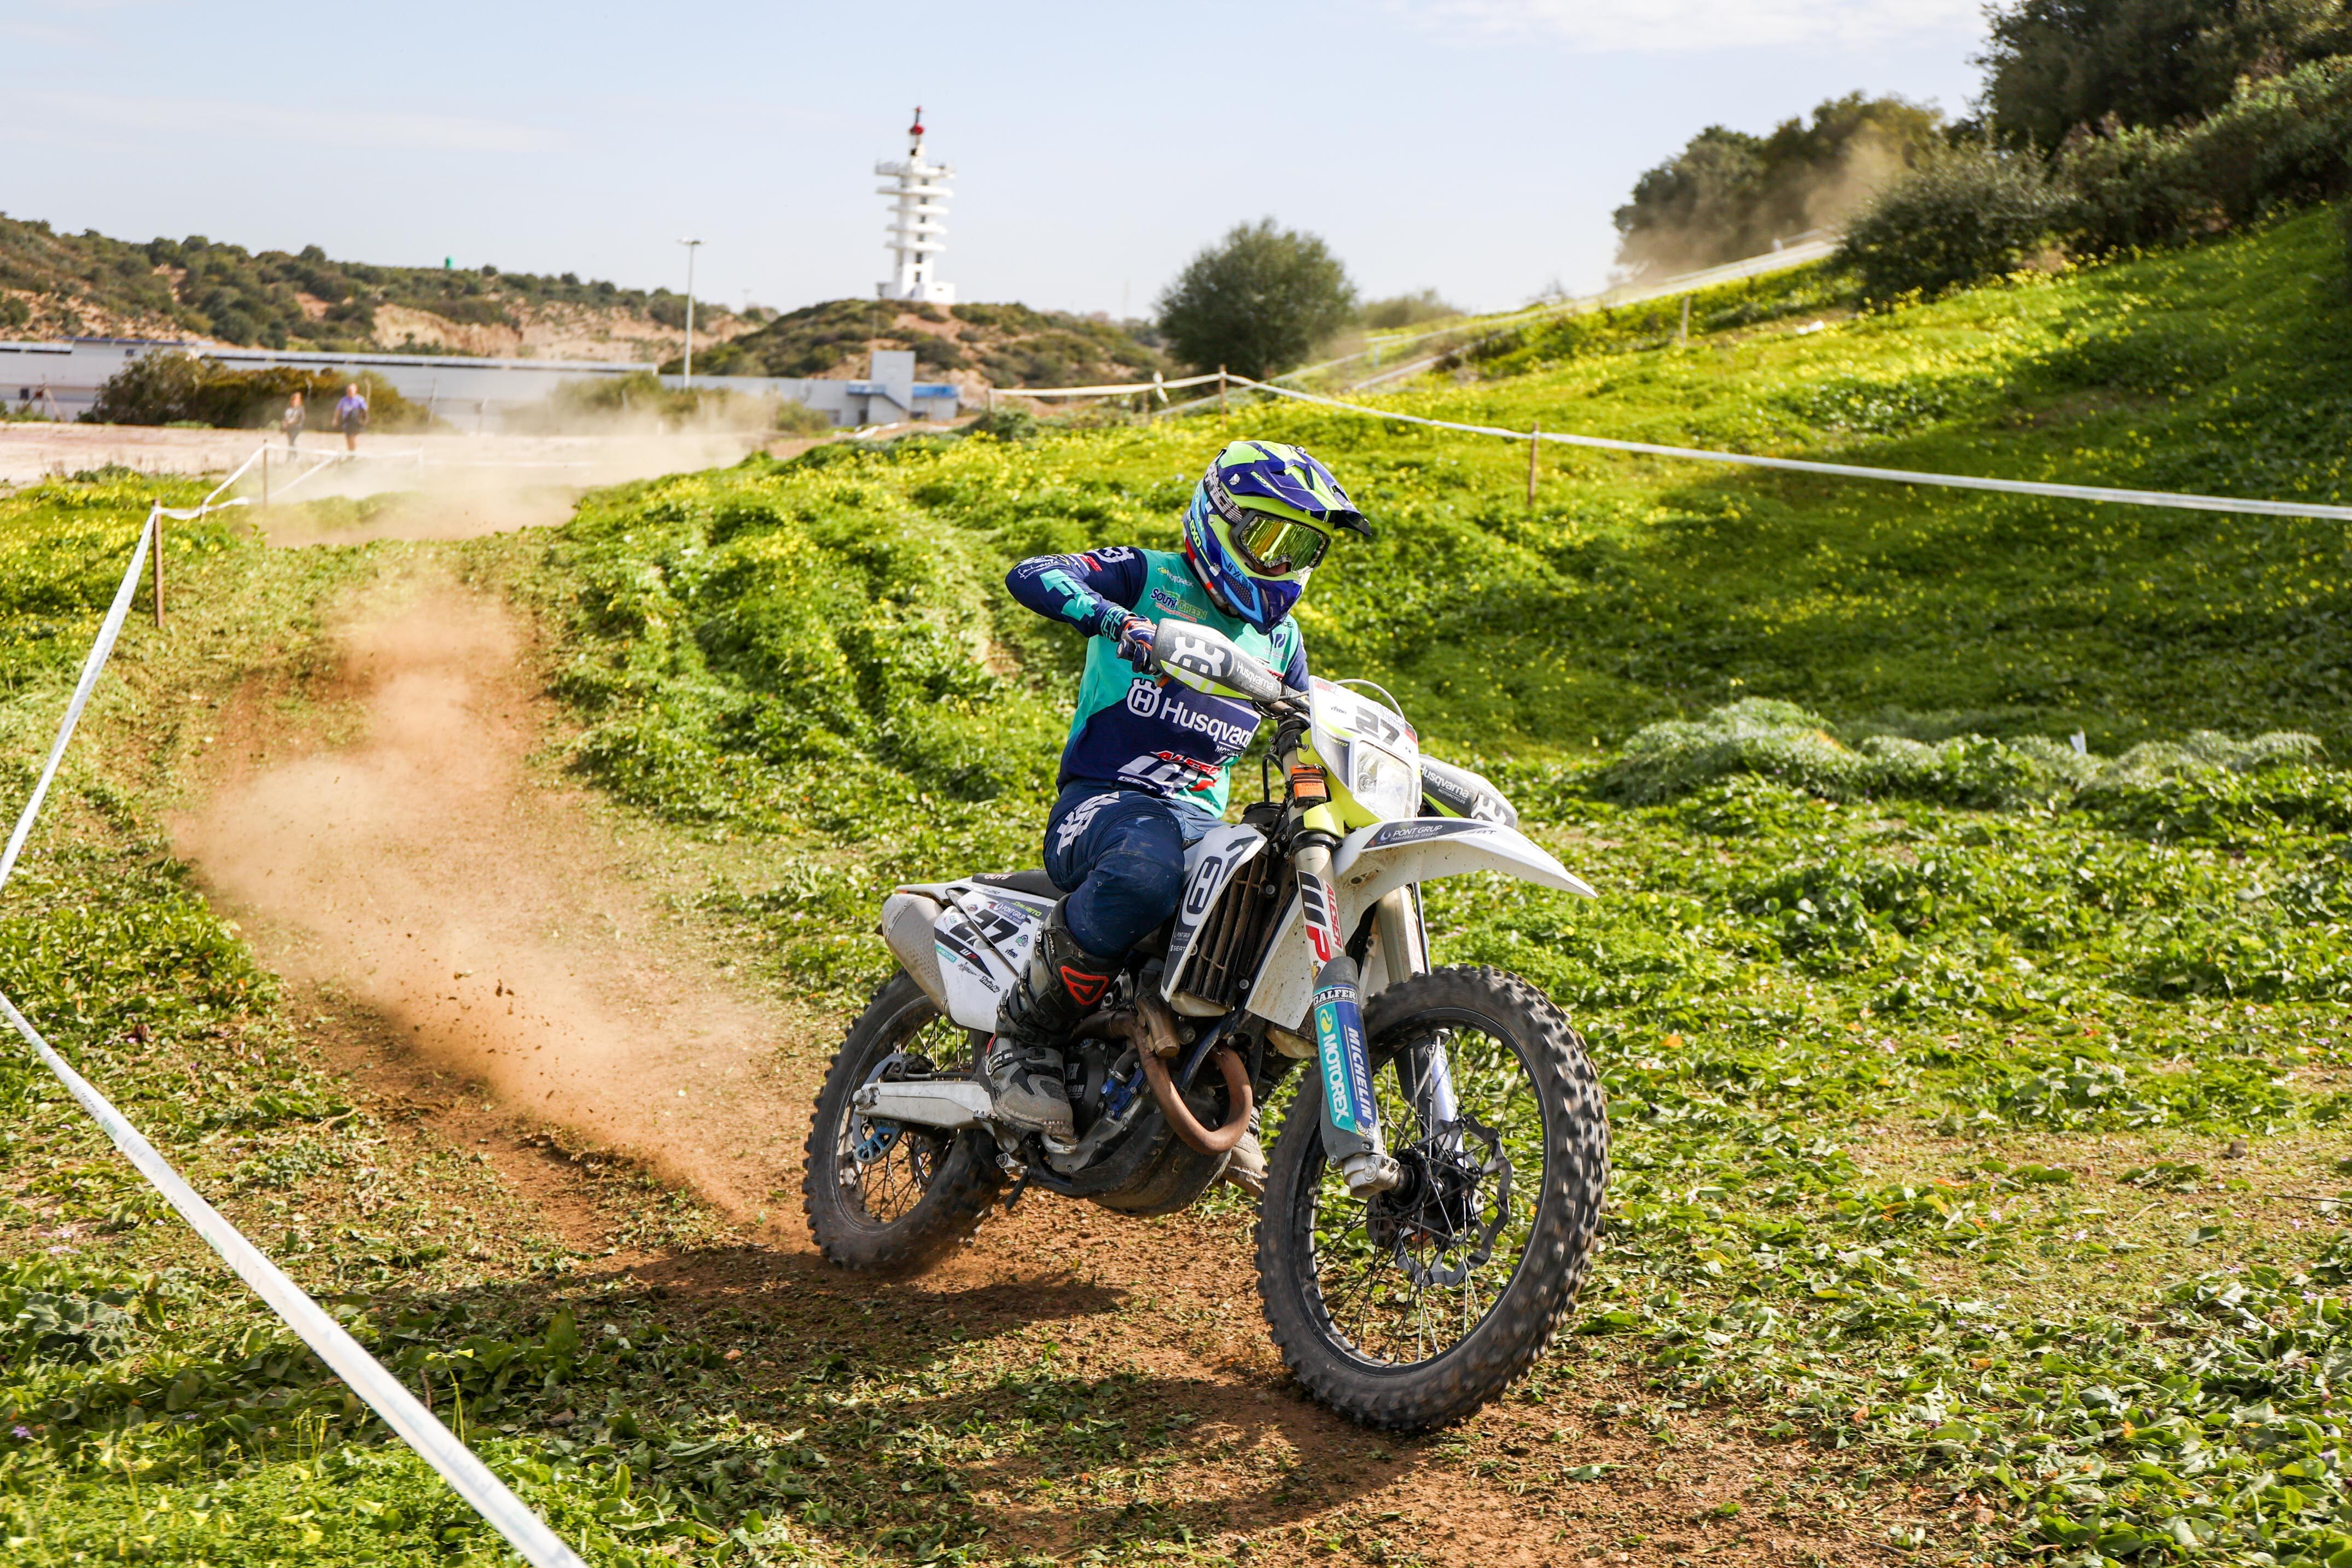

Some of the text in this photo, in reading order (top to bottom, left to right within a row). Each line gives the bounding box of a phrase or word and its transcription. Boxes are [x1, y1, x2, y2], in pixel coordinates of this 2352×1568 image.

[1150, 588, 1208, 620] SOUTH GREEN
[1237, 661, 1274, 692] Husqvarna
[1356, 705, 1400, 747] 27
[1438, 788, 1466, 805] MOTORCYCLES
[1393, 825, 1443, 837] PONT GRUP
[1002, 905, 1015, 916] PONT
[1012, 910, 1026, 920] GRUP
[1326, 883, 1342, 949] ALESER
[1313, 989, 1357, 1006] GALFER
[1323, 1033, 1350, 1123] MOTOREX
[1348, 1027, 1372, 1121] MICHELIN
